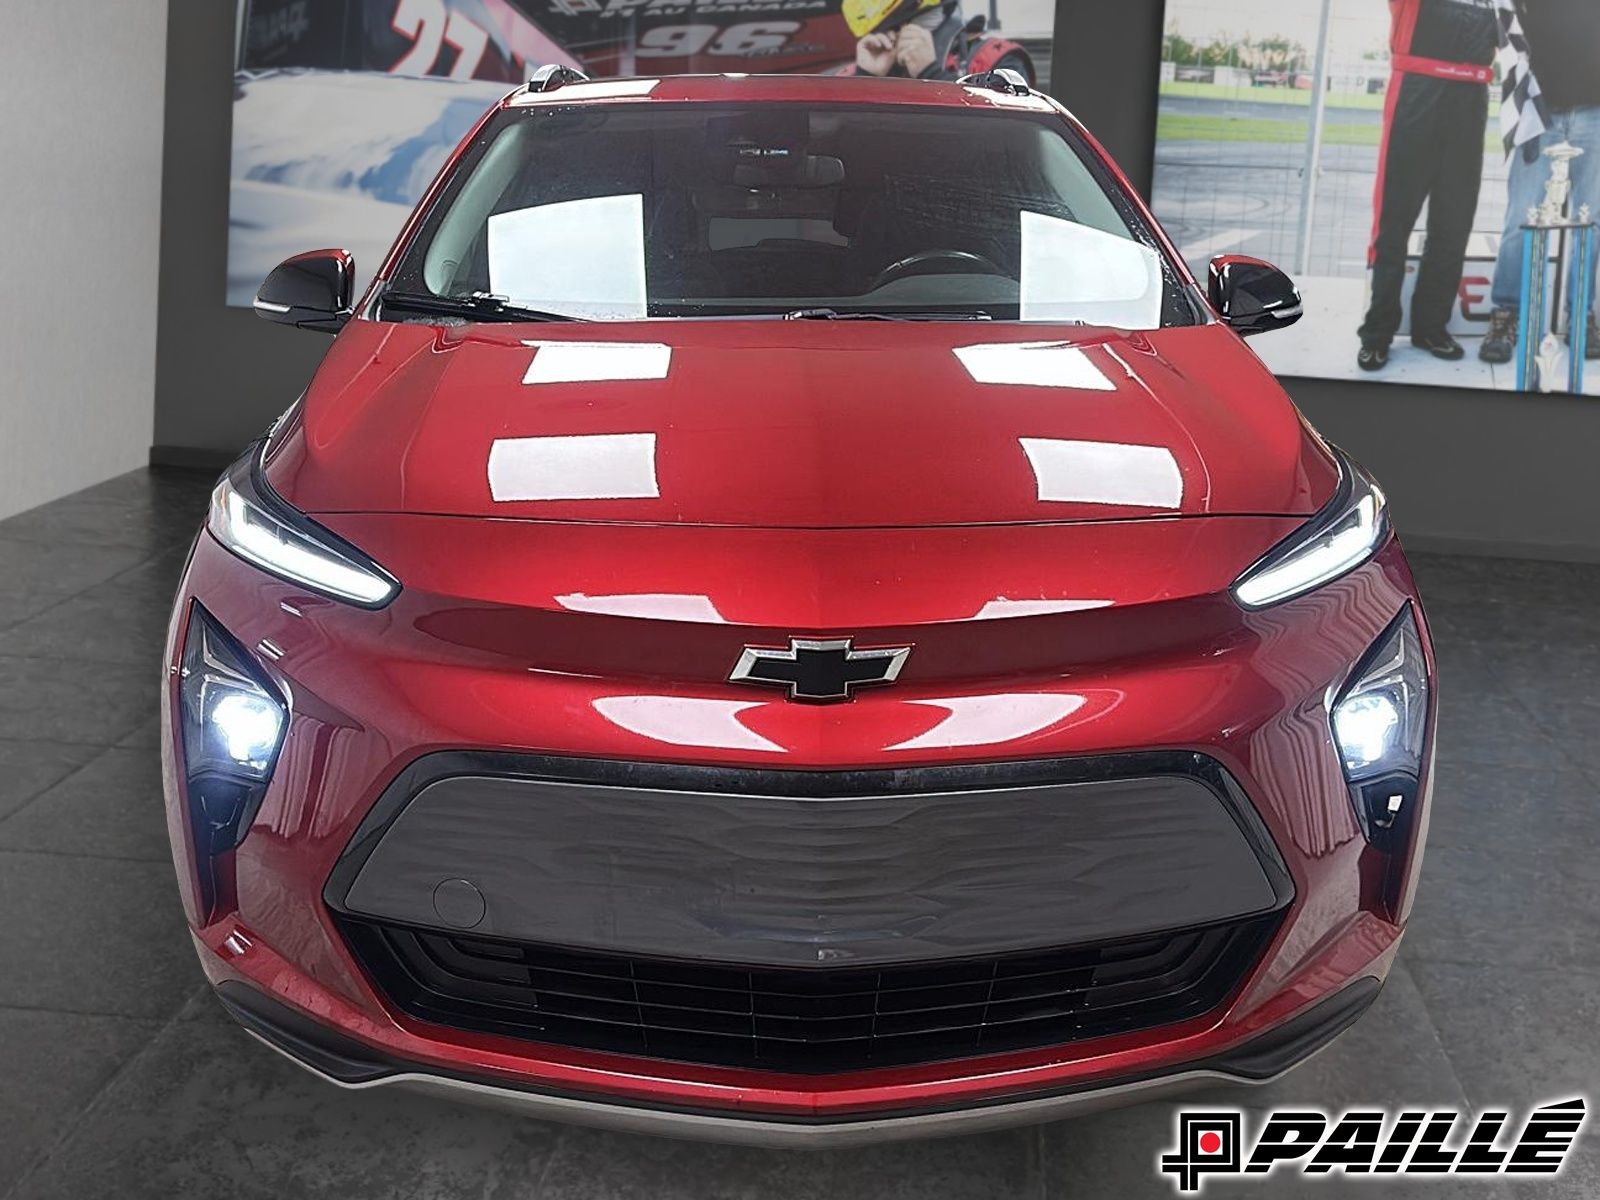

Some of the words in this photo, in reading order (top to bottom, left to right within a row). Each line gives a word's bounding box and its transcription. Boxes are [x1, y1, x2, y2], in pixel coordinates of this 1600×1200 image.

[643, 7, 686, 16] AU
[696, 1, 826, 13] CANADA
[634, 21, 801, 58] 96
